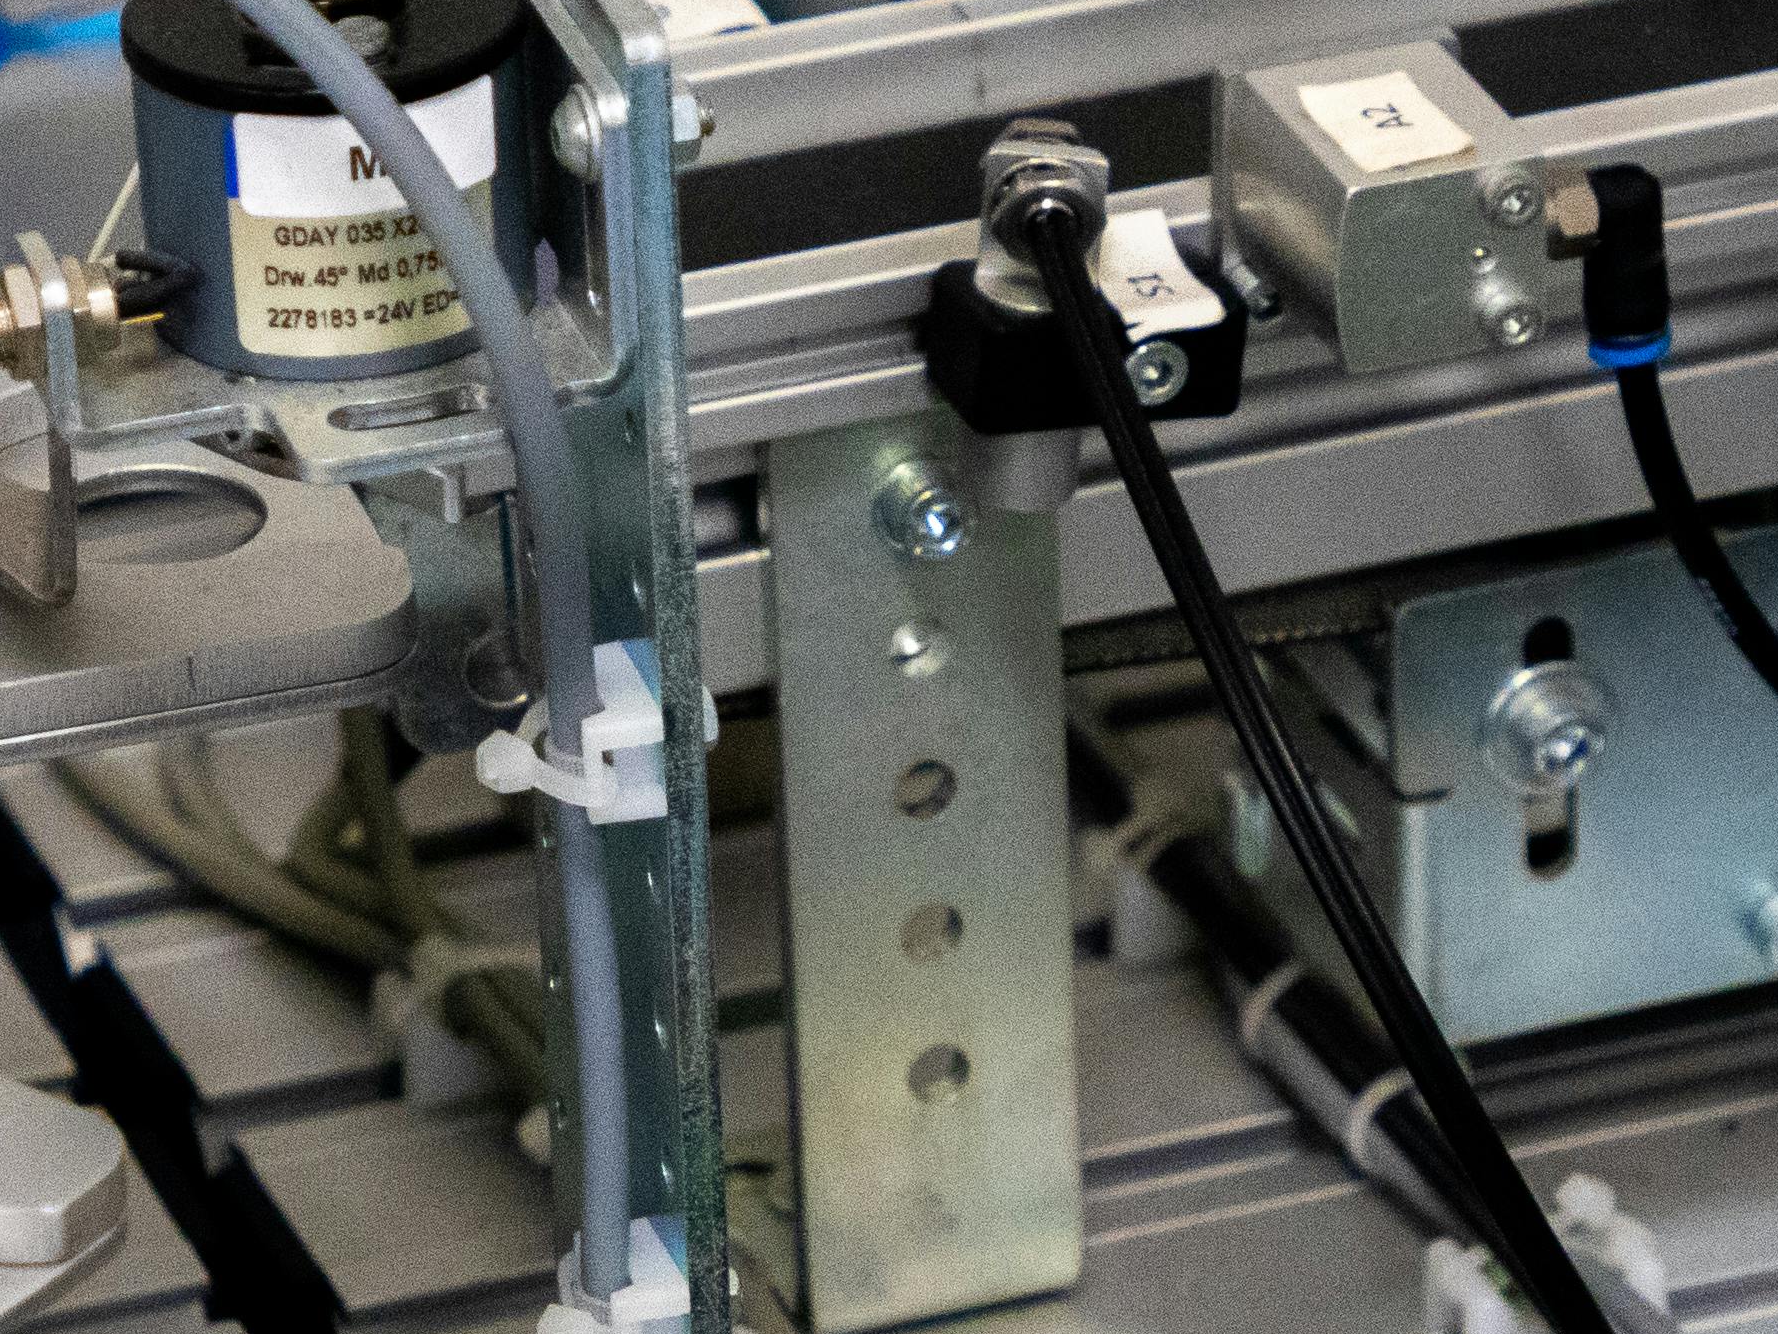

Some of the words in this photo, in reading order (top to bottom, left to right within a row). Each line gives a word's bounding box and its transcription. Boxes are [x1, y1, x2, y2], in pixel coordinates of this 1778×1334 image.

[1361, 102, 1414, 132] A2
[273, 224, 339, 247] GDAY
[346, 219, 386, 246] 035
[357, 262, 391, 285] Md
[266, 306, 357, 330] 2278183
